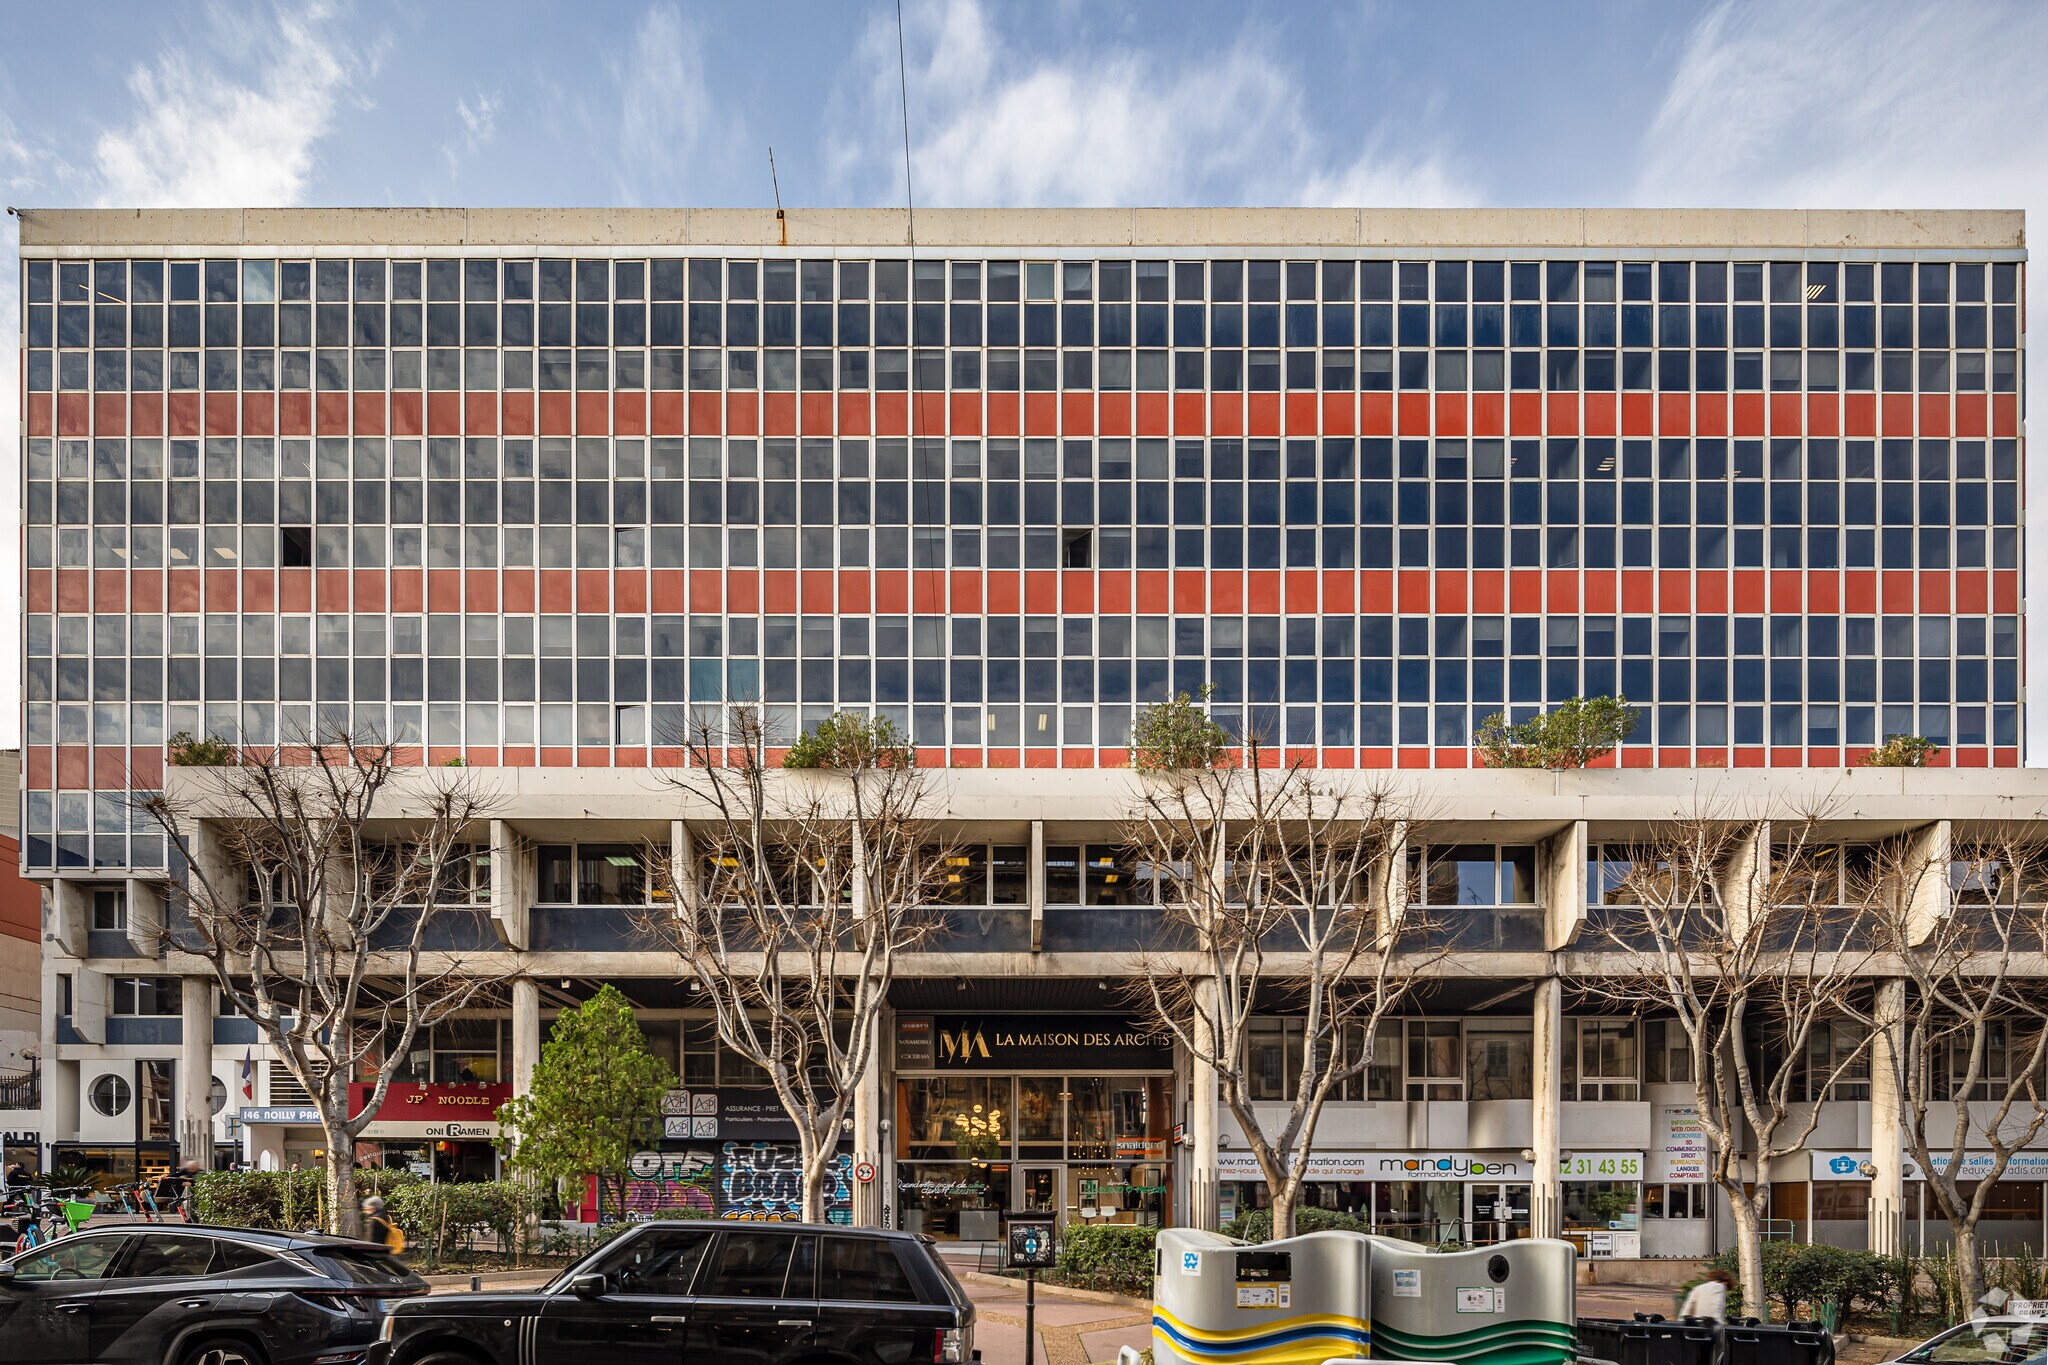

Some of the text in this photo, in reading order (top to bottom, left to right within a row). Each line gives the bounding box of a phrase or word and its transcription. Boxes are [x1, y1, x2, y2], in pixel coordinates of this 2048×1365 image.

[996, 1033, 1015, 1046] LA
[1018, 1033, 1079, 1046] MAISON
[1083, 1033, 1111, 1046] DES
[438, 1096, 490, 1105] NOODLE
[243, 1111, 321, 1120] 146 NOILLY PAR
[426, 1123, 490, 1137] ONI RAMEN
[2, 1132, 40, 1144] ALDI
[1116, 1141, 1163, 1150] snaidero
[1968, 1156, 1994, 1165] salles
[1322, 1167, 1334, 1175] qui
[1336, 1167, 1365, 1175] change
[1380, 1155, 1517, 1178] mandyben
[1576, 1159, 1592, 1174] 31
[1598, 1159, 1616, 1174] 43
[1620, 1159, 1638, 1174] 55
[2011, 1301, 2048, 1309] PROPRIET
